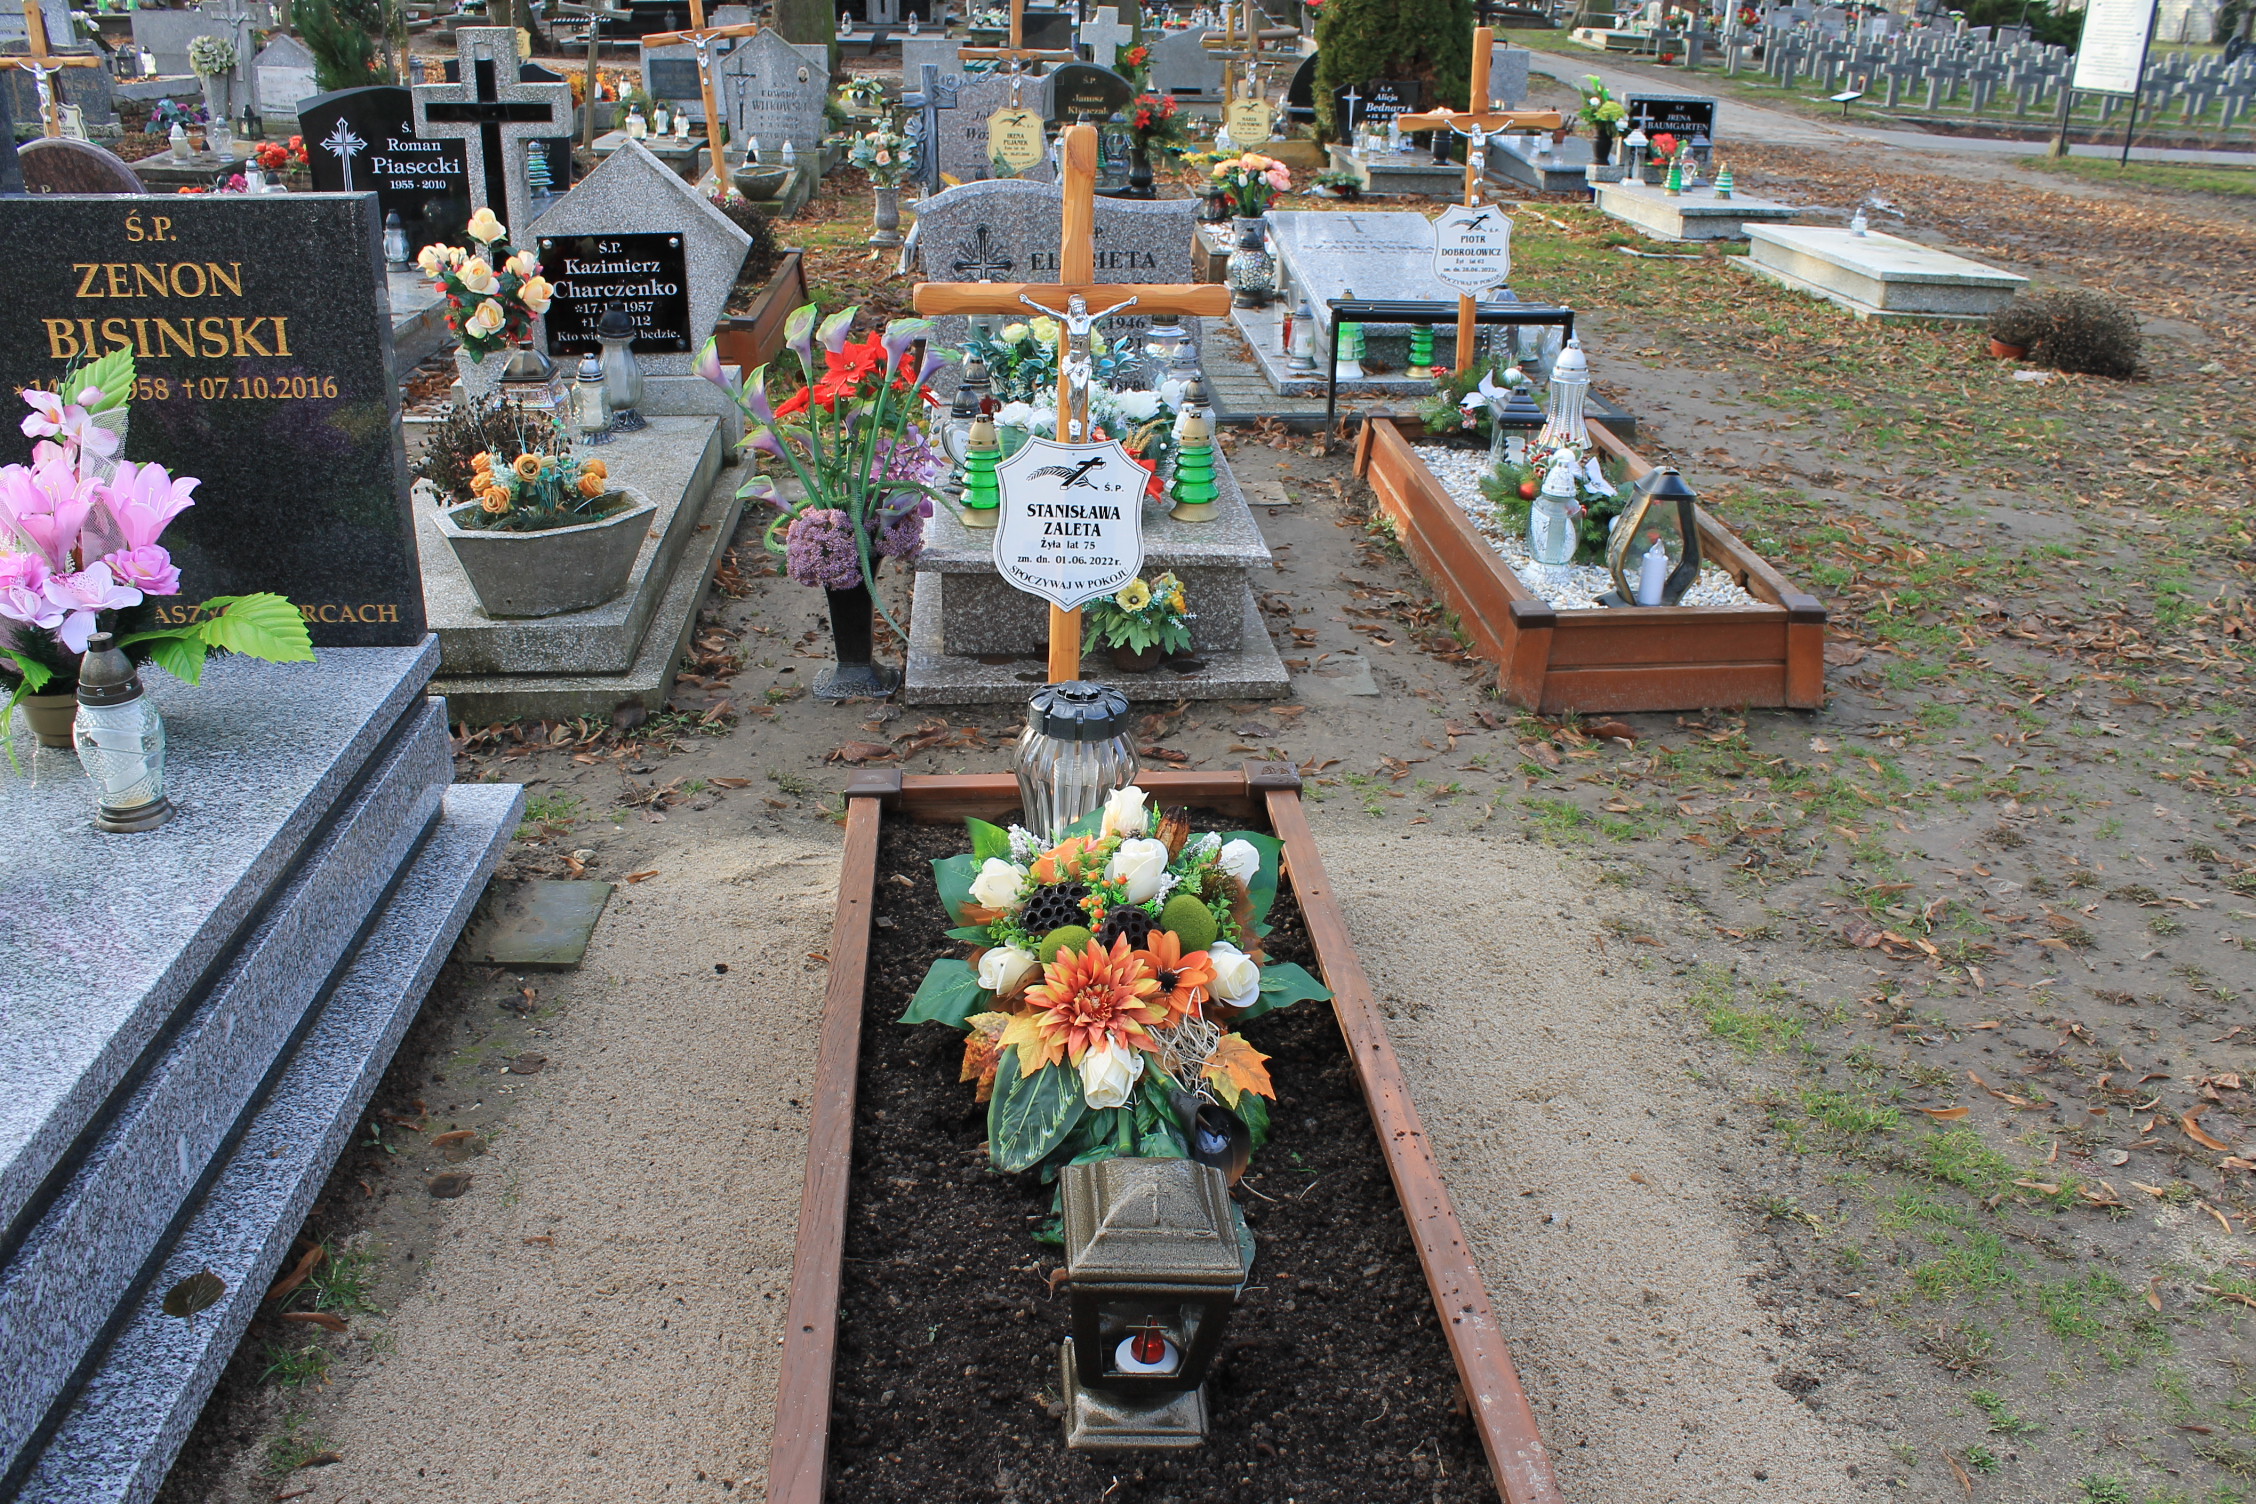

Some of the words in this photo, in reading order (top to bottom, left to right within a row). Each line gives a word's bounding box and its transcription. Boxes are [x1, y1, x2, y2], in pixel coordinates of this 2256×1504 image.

[1374, 94, 1398, 103] Alicja
[1647, 121, 1709, 131] BAUMGARTEN
[387, 138, 442, 152] Roman
[371, 156, 461, 175] Piasecki
[390, 180, 415, 190] 1955
[421, 180, 447, 190] 2010
[126, 209, 178, 242] Ś.P.
[1460, 235, 1486, 243] PIOTR
[598, 241, 622, 254] Ś.P.
[1441, 248, 1501, 256] DOBROŁOWICZ
[564, 259, 660, 275] Kazimierz
[72, 262, 243, 298] ZENON
[553, 278, 678, 299] Charczenko
[41, 316, 293, 359] BISINSKI
[557, 331, 578, 341] Kto
[1104, 482, 1124, 492] Ś.P.
[1027, 503, 1121, 520] STANISŁAWA
[1043, 522, 1102, 537] ZALETA
[1040, 537, 1061, 550] Żyła
[1067, 541, 1079, 549] lat
[1084, 541, 1096, 549] 75
[1036, 555, 1050, 563] dn.
[1009, 565, 1072, 589] SPOCZYWAJ
[1088, 567, 1129, 589] POKOJU
